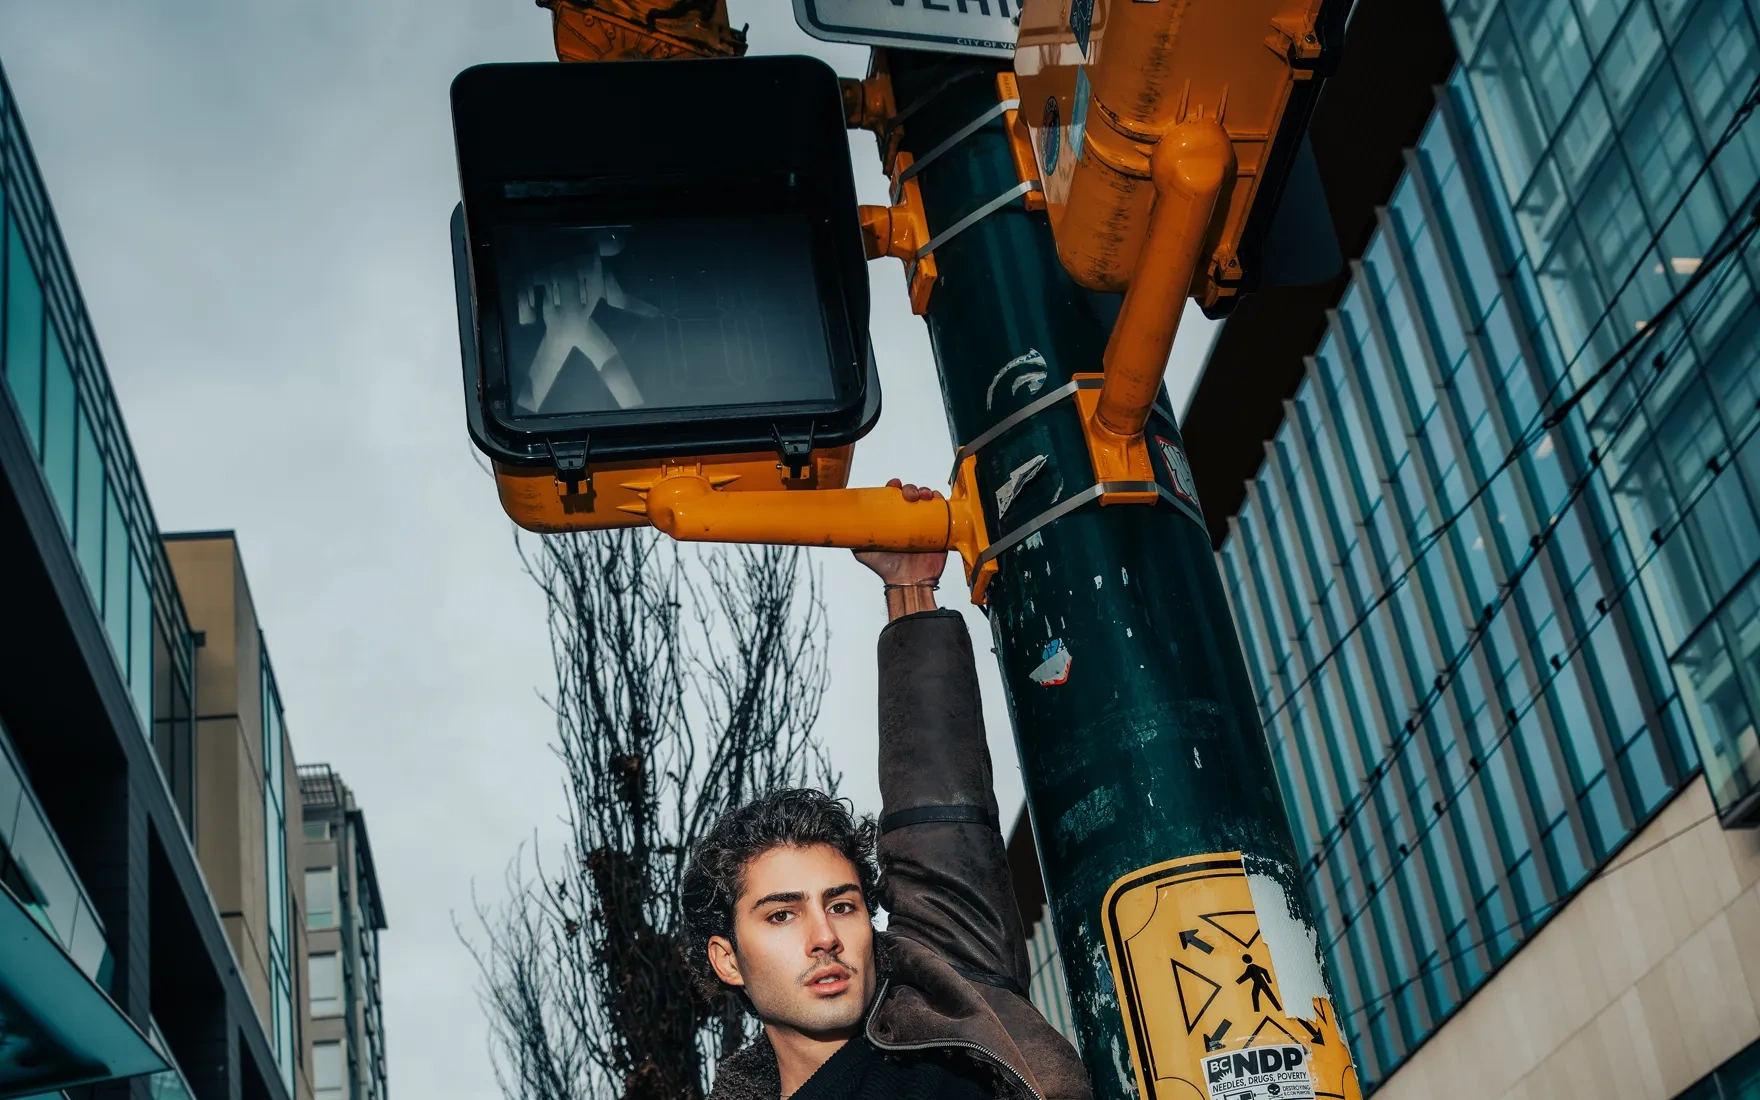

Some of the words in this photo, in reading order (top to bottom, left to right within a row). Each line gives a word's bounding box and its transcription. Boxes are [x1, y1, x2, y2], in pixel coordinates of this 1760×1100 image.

[956, 38, 980, 46] CITY
[1210, 1058, 1230, 1073] BC
[1232, 1047, 1303, 1078] NDP
[1212, 1079, 1247, 1093] NEEDLES,
[1248, 1073, 1276, 1085] DRUGS,
[1277, 1071, 1307, 1081] POVERTY
